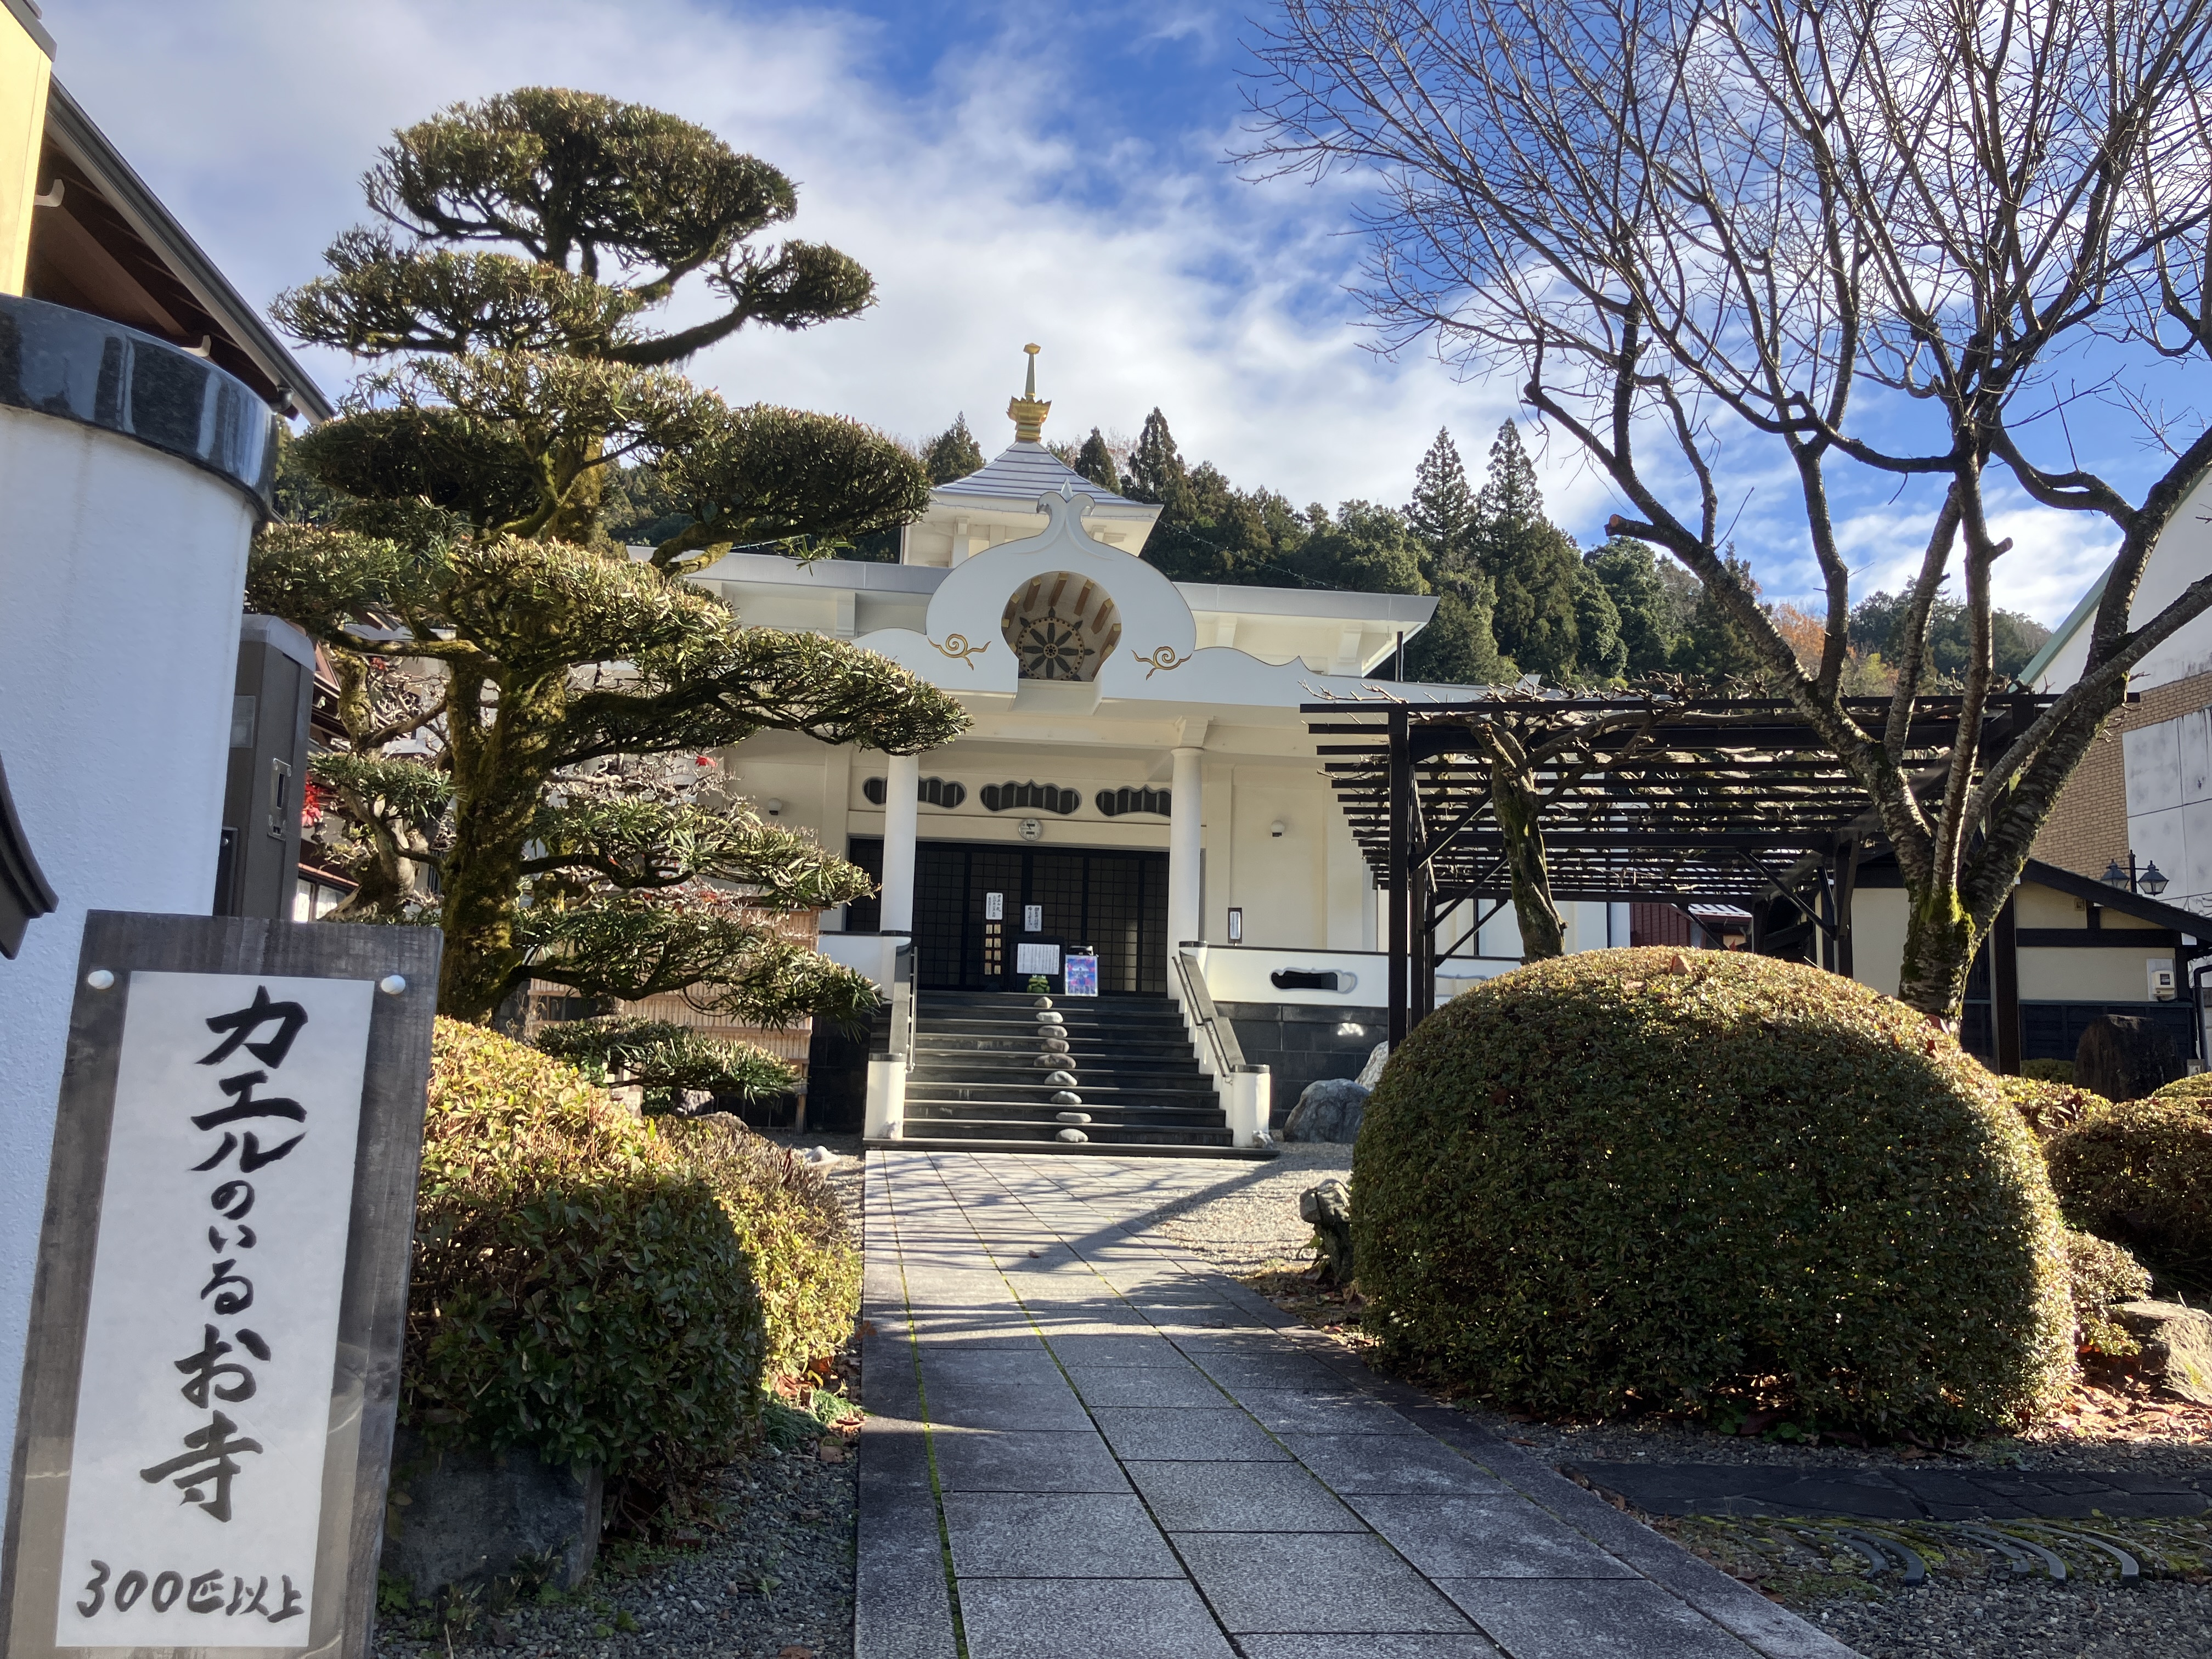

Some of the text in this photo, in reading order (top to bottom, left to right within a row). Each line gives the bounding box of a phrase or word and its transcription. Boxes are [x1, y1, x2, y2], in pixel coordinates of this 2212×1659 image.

[140, 985, 308, 1523] カエルのいるお寺
[77, 1560, 306, 1623] 300匹以上
